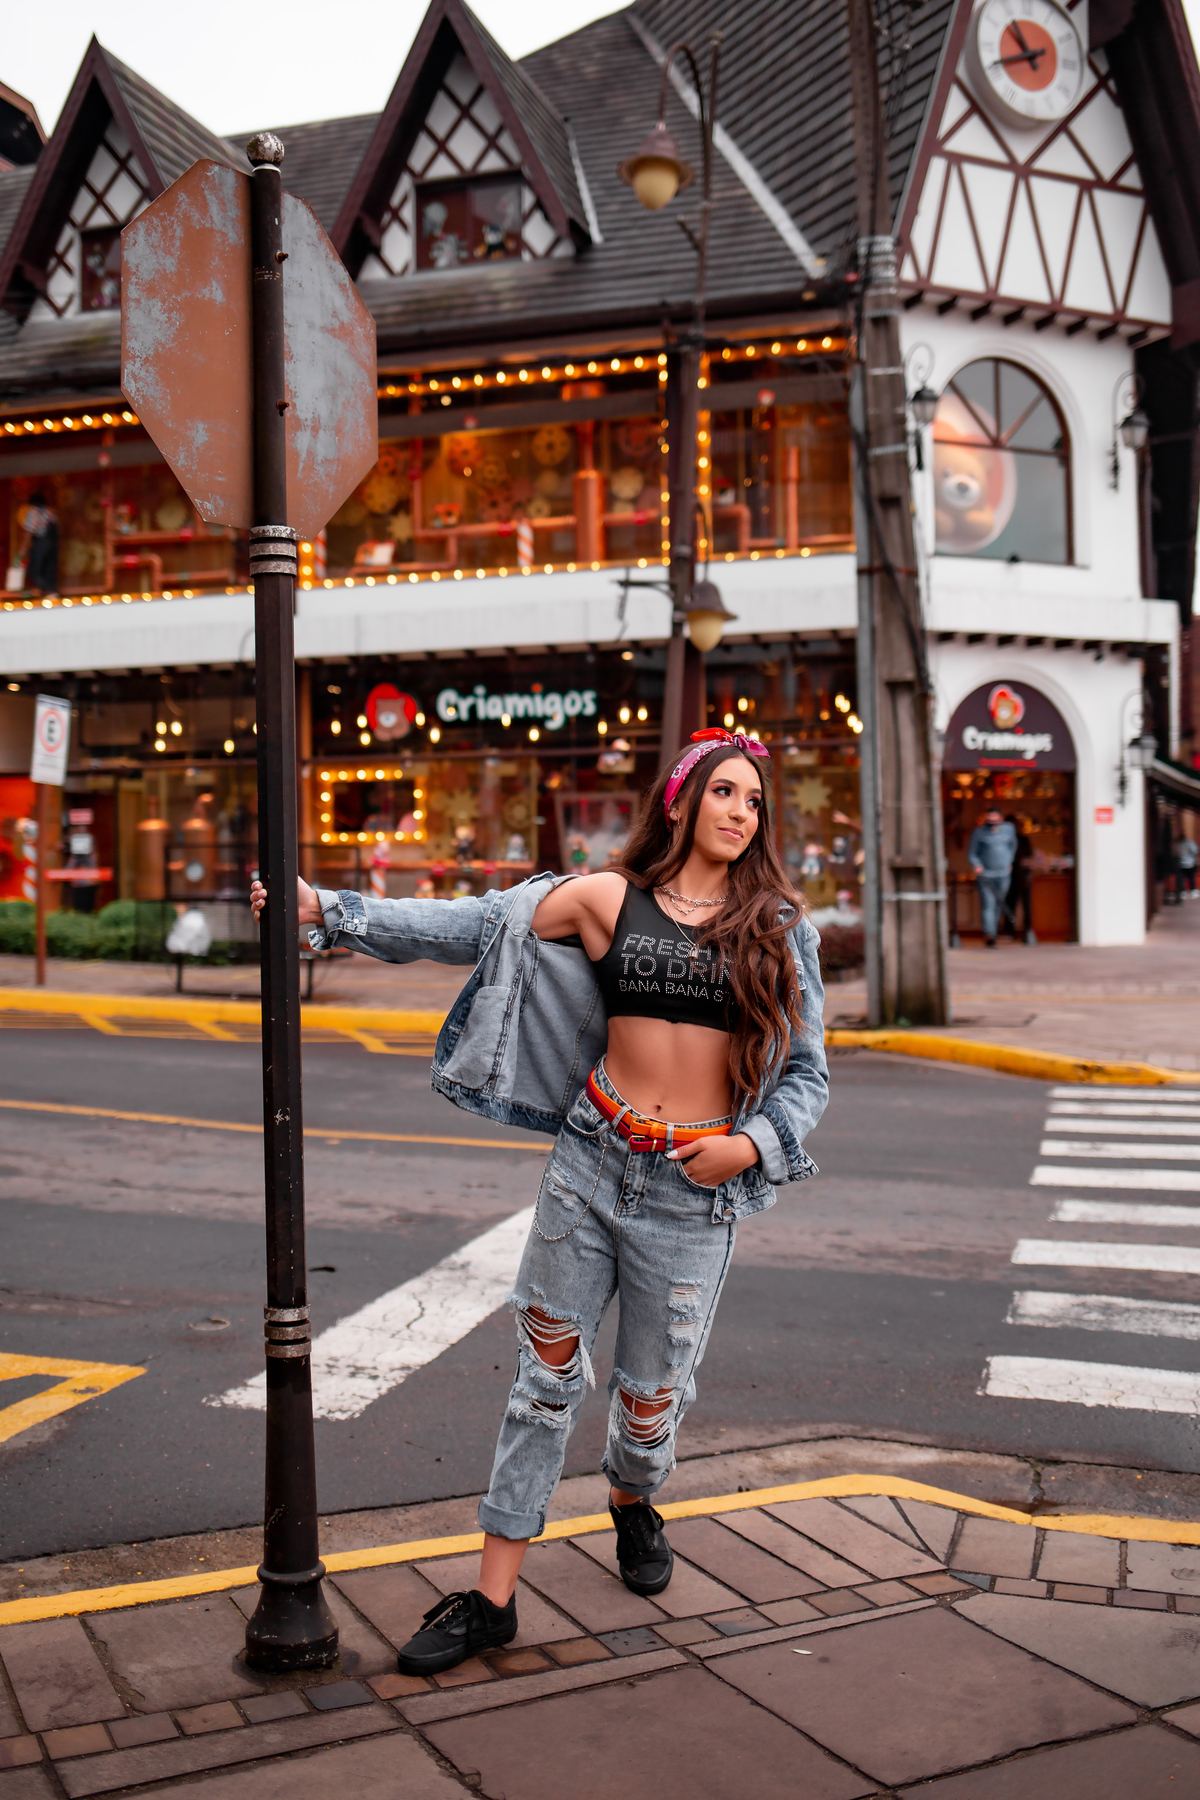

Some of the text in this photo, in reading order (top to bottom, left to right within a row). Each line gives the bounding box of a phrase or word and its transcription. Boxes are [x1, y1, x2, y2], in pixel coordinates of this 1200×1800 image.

[436, 683, 597, 731] Criamigos
[621, 933, 712, 961] FRESH
[620, 953, 657, 977] TO
[618, 979, 661, 993] BANA
[665, 982, 710, 1000] BANA
